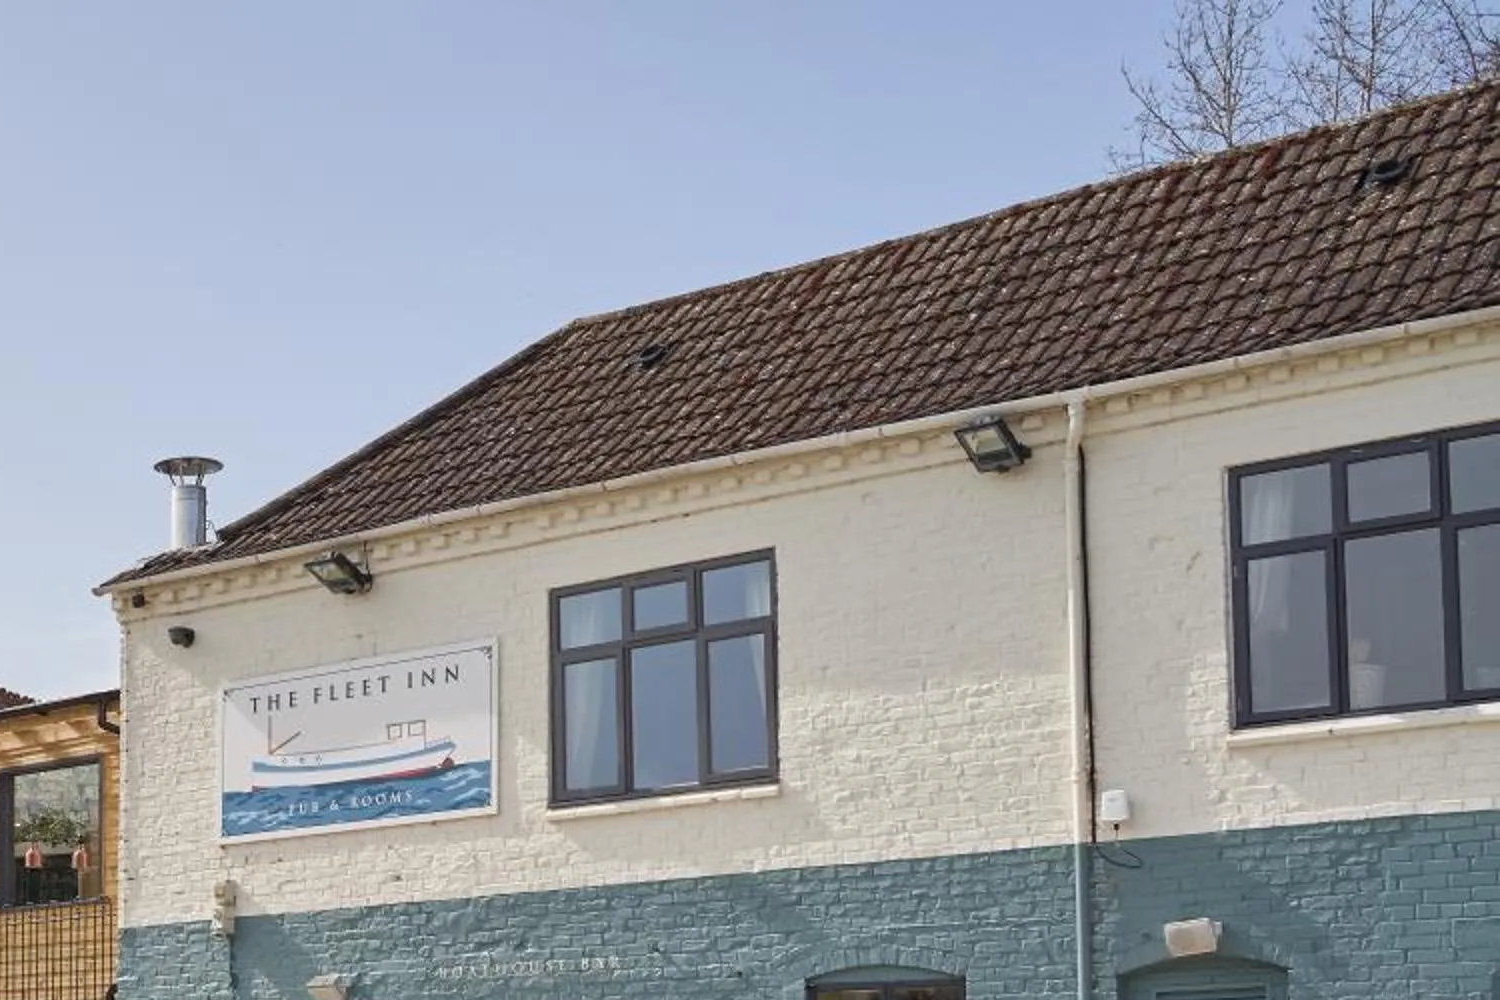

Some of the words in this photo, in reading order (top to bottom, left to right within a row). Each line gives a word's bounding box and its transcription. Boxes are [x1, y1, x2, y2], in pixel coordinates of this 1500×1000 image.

[250, 691, 298, 713] THE
[313, 675, 391, 704] FLEET
[407, 664, 460, 689] INN
[288, 801, 319, 816] PUB
[329, 799, 340, 811] &
[350, 789, 414, 808] ROOMS
